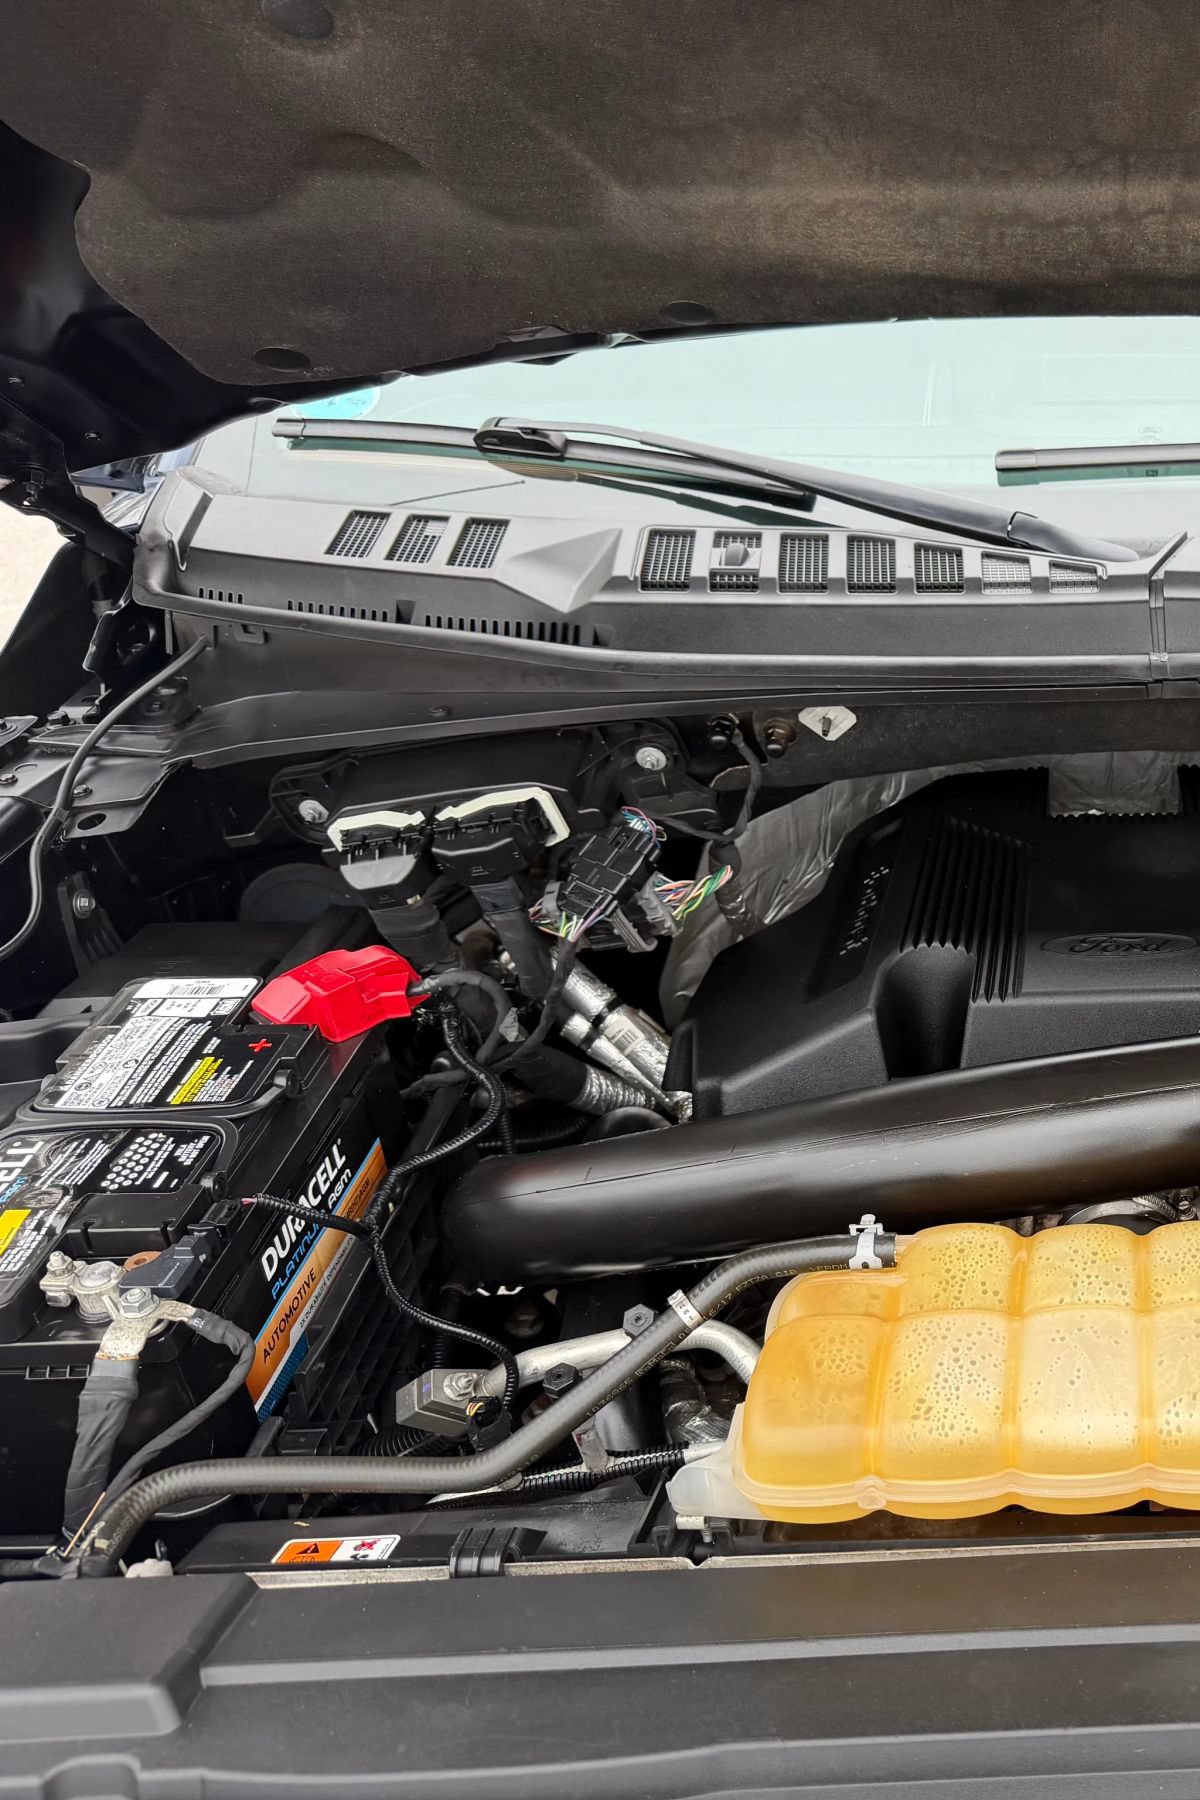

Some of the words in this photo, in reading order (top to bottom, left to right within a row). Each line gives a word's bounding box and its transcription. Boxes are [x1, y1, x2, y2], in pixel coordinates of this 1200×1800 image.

[1069, 936, 1169, 953] Ford
[271, 1215, 324, 1301] PLATINU
[326, 1168, 352, 1210] AGM
[263, 1267, 317, 1364] AUTOMOTIVE
